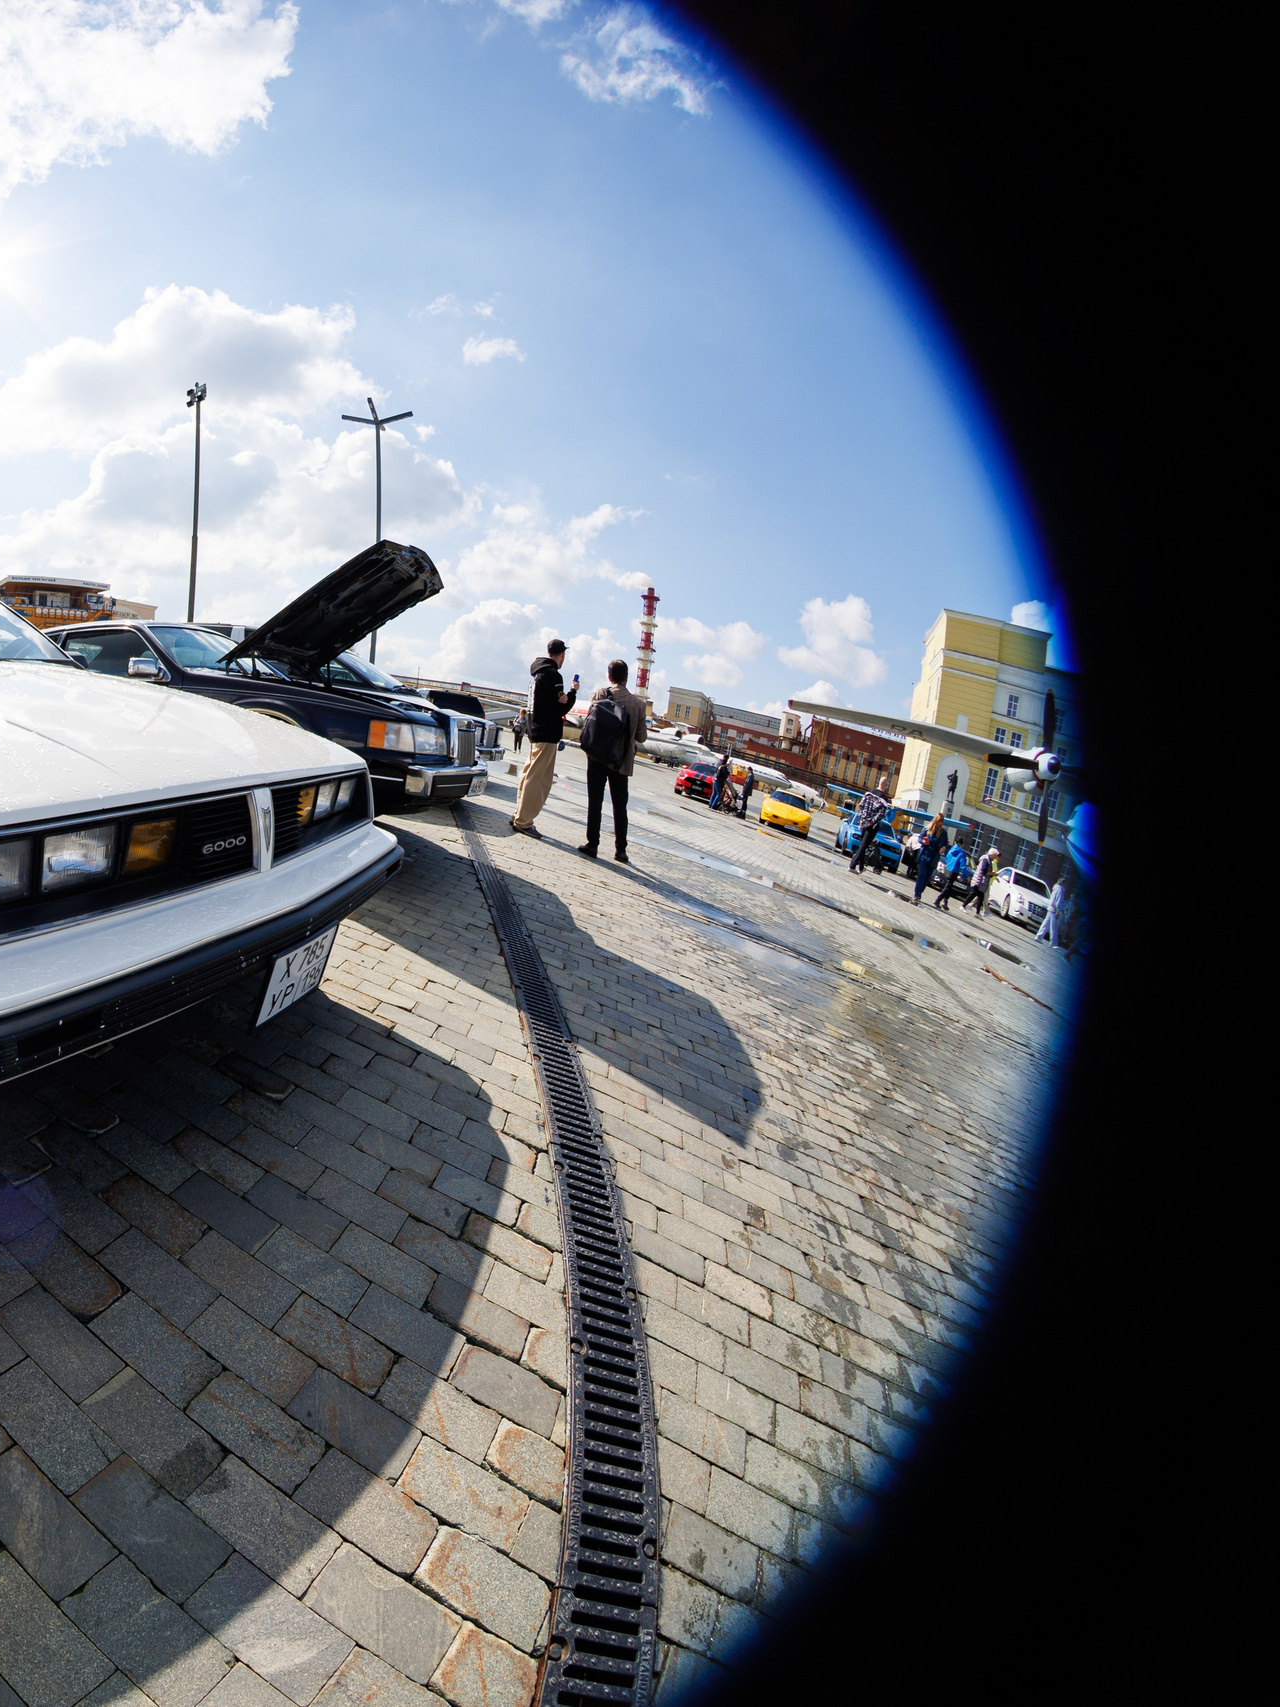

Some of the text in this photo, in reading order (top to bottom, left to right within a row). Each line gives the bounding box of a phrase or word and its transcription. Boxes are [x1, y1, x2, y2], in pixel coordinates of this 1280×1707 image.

[202, 836, 247, 854] 6000
[298, 934, 328, 972] 785
[302, 962, 323, 987] 196
